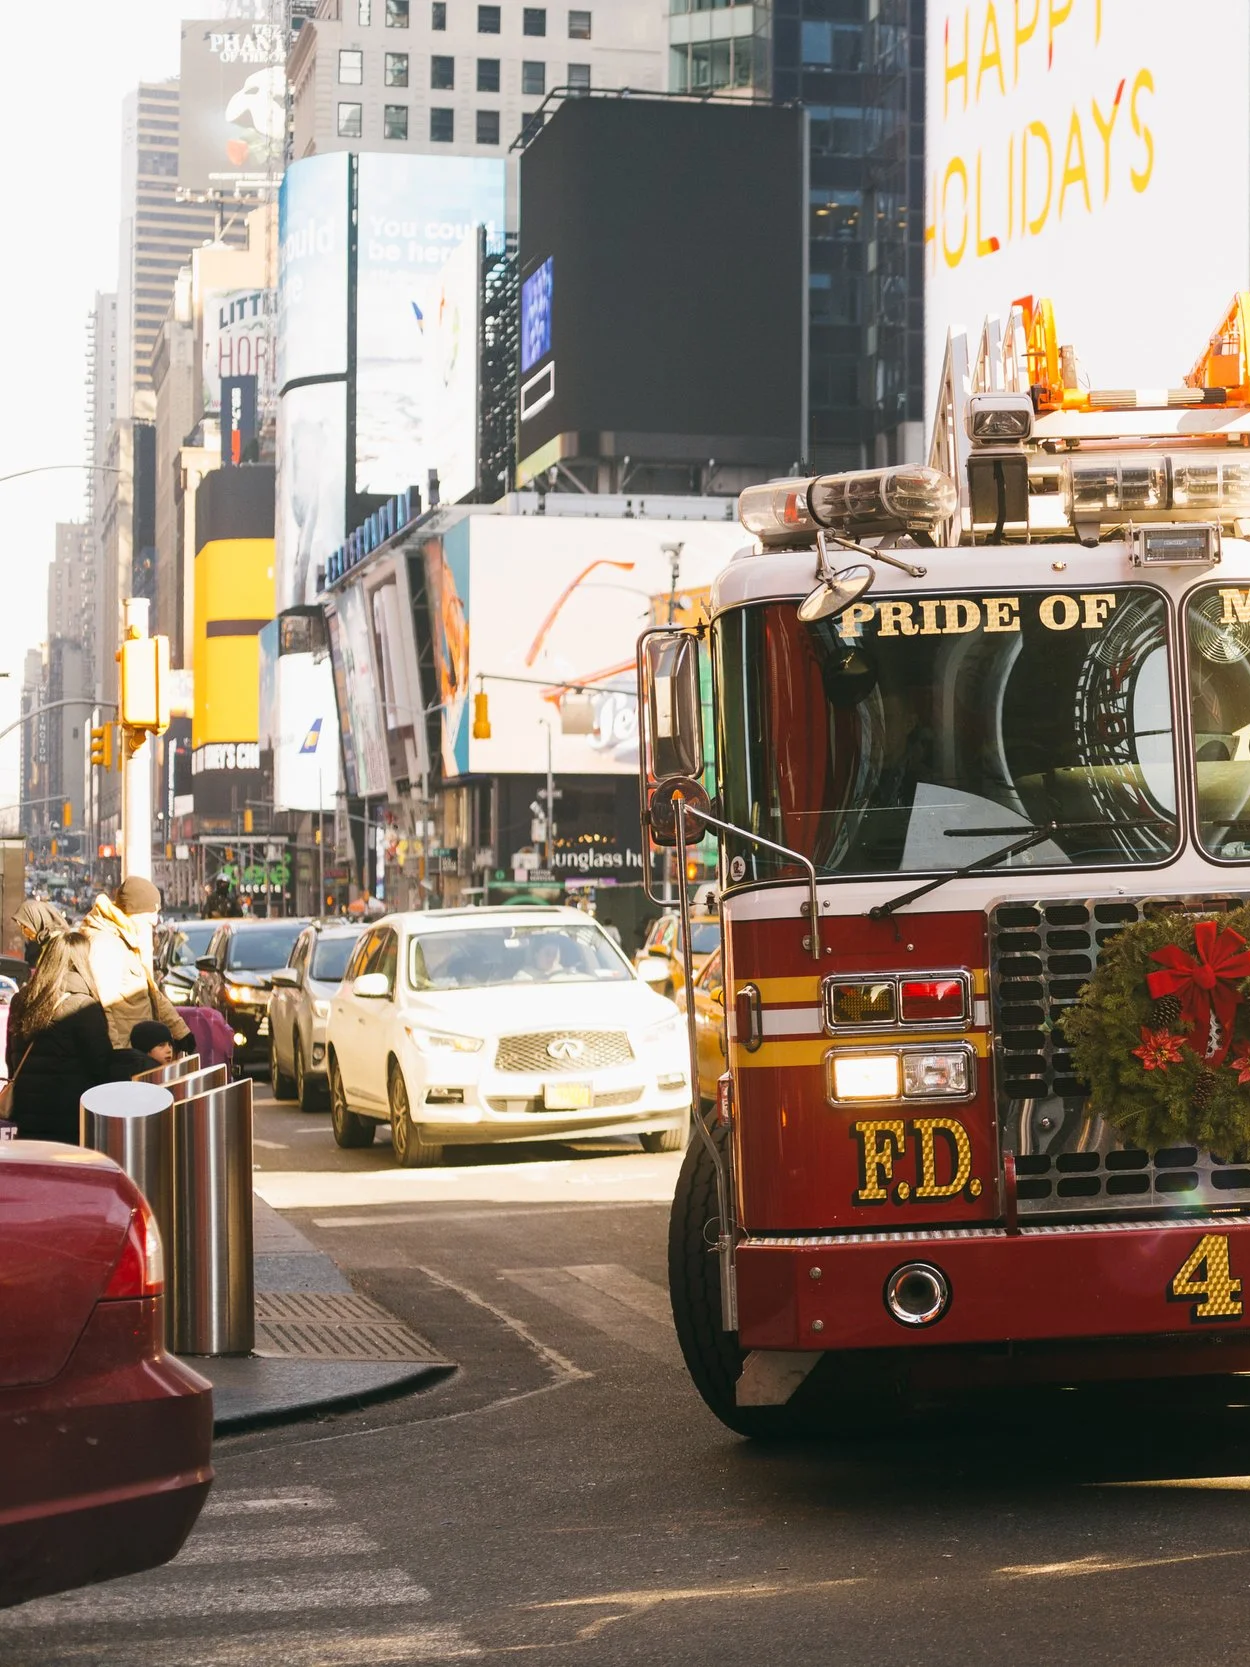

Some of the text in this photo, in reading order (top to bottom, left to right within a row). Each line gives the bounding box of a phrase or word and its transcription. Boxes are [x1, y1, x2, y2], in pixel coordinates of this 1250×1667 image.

[369, 240, 400, 262] be
[370, 216, 496, 241] You coud
[219, 335, 277, 384] HOR
[839, 593, 1117, 638] PRIDE OF
[856, 1118, 982, 1200] F.D.
[1173, 1234, 1242, 1316] 4
